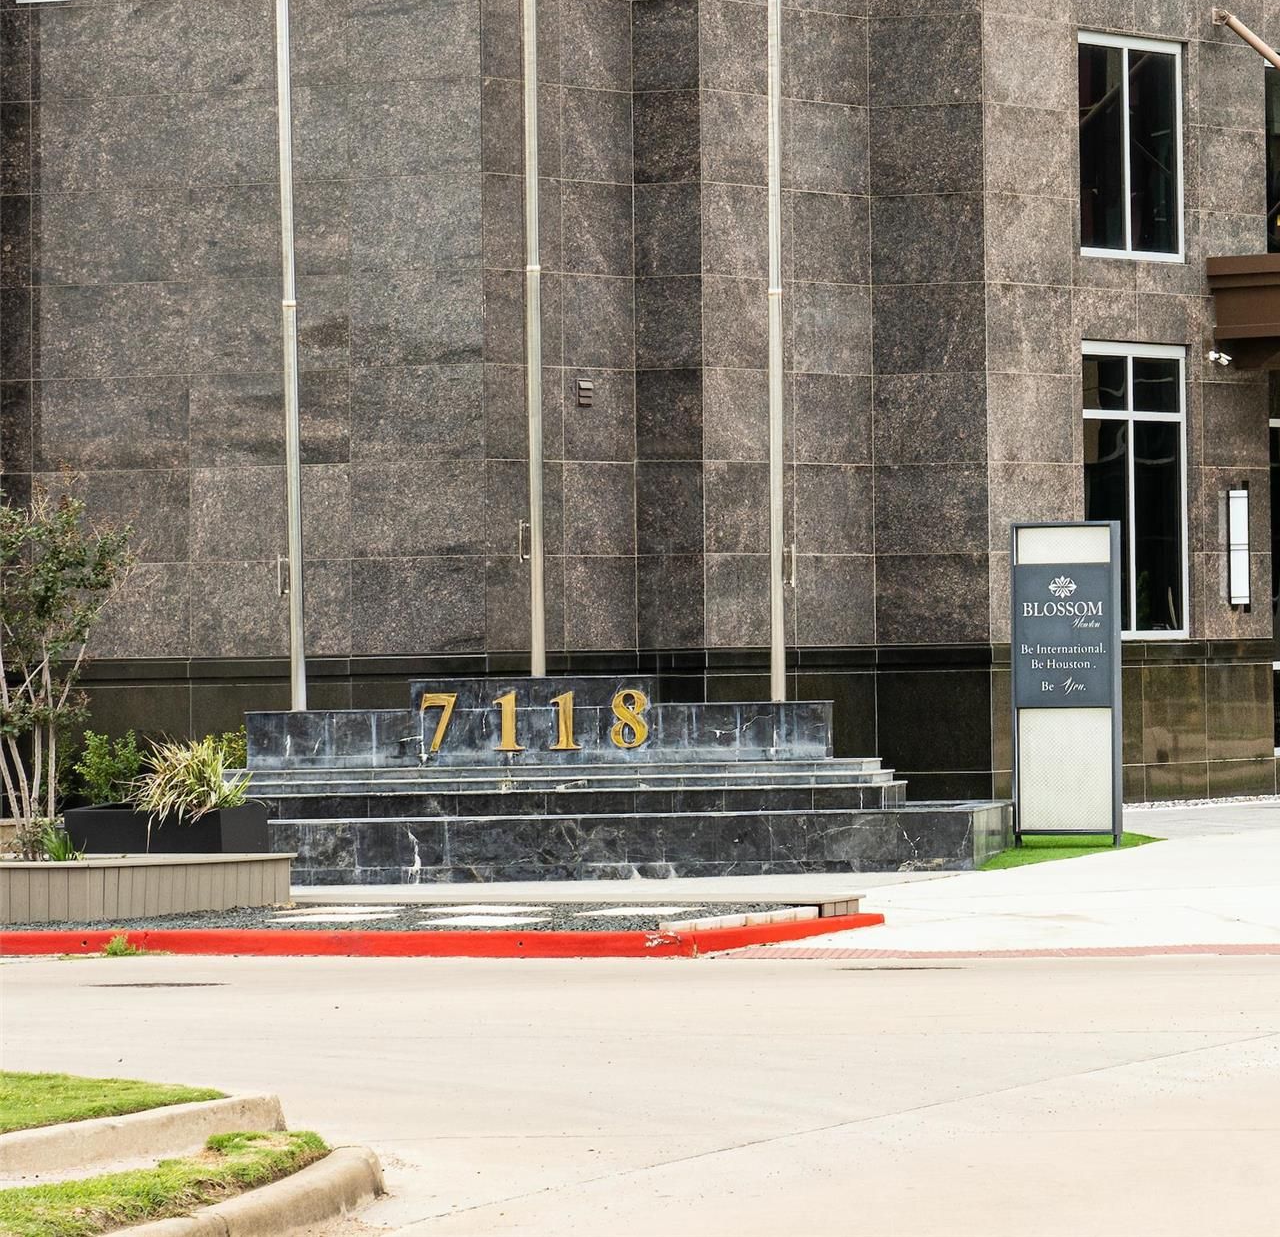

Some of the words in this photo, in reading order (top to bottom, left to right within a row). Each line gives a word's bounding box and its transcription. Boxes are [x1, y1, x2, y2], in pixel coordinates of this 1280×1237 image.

[1022, 601, 1103, 617] BLOSSOM
[1021, 644, 1034, 654] Be
[1037, 642, 1107, 654] International.
[1031, 659, 1044, 669] Be
[1041, 681, 1055, 692] Be
